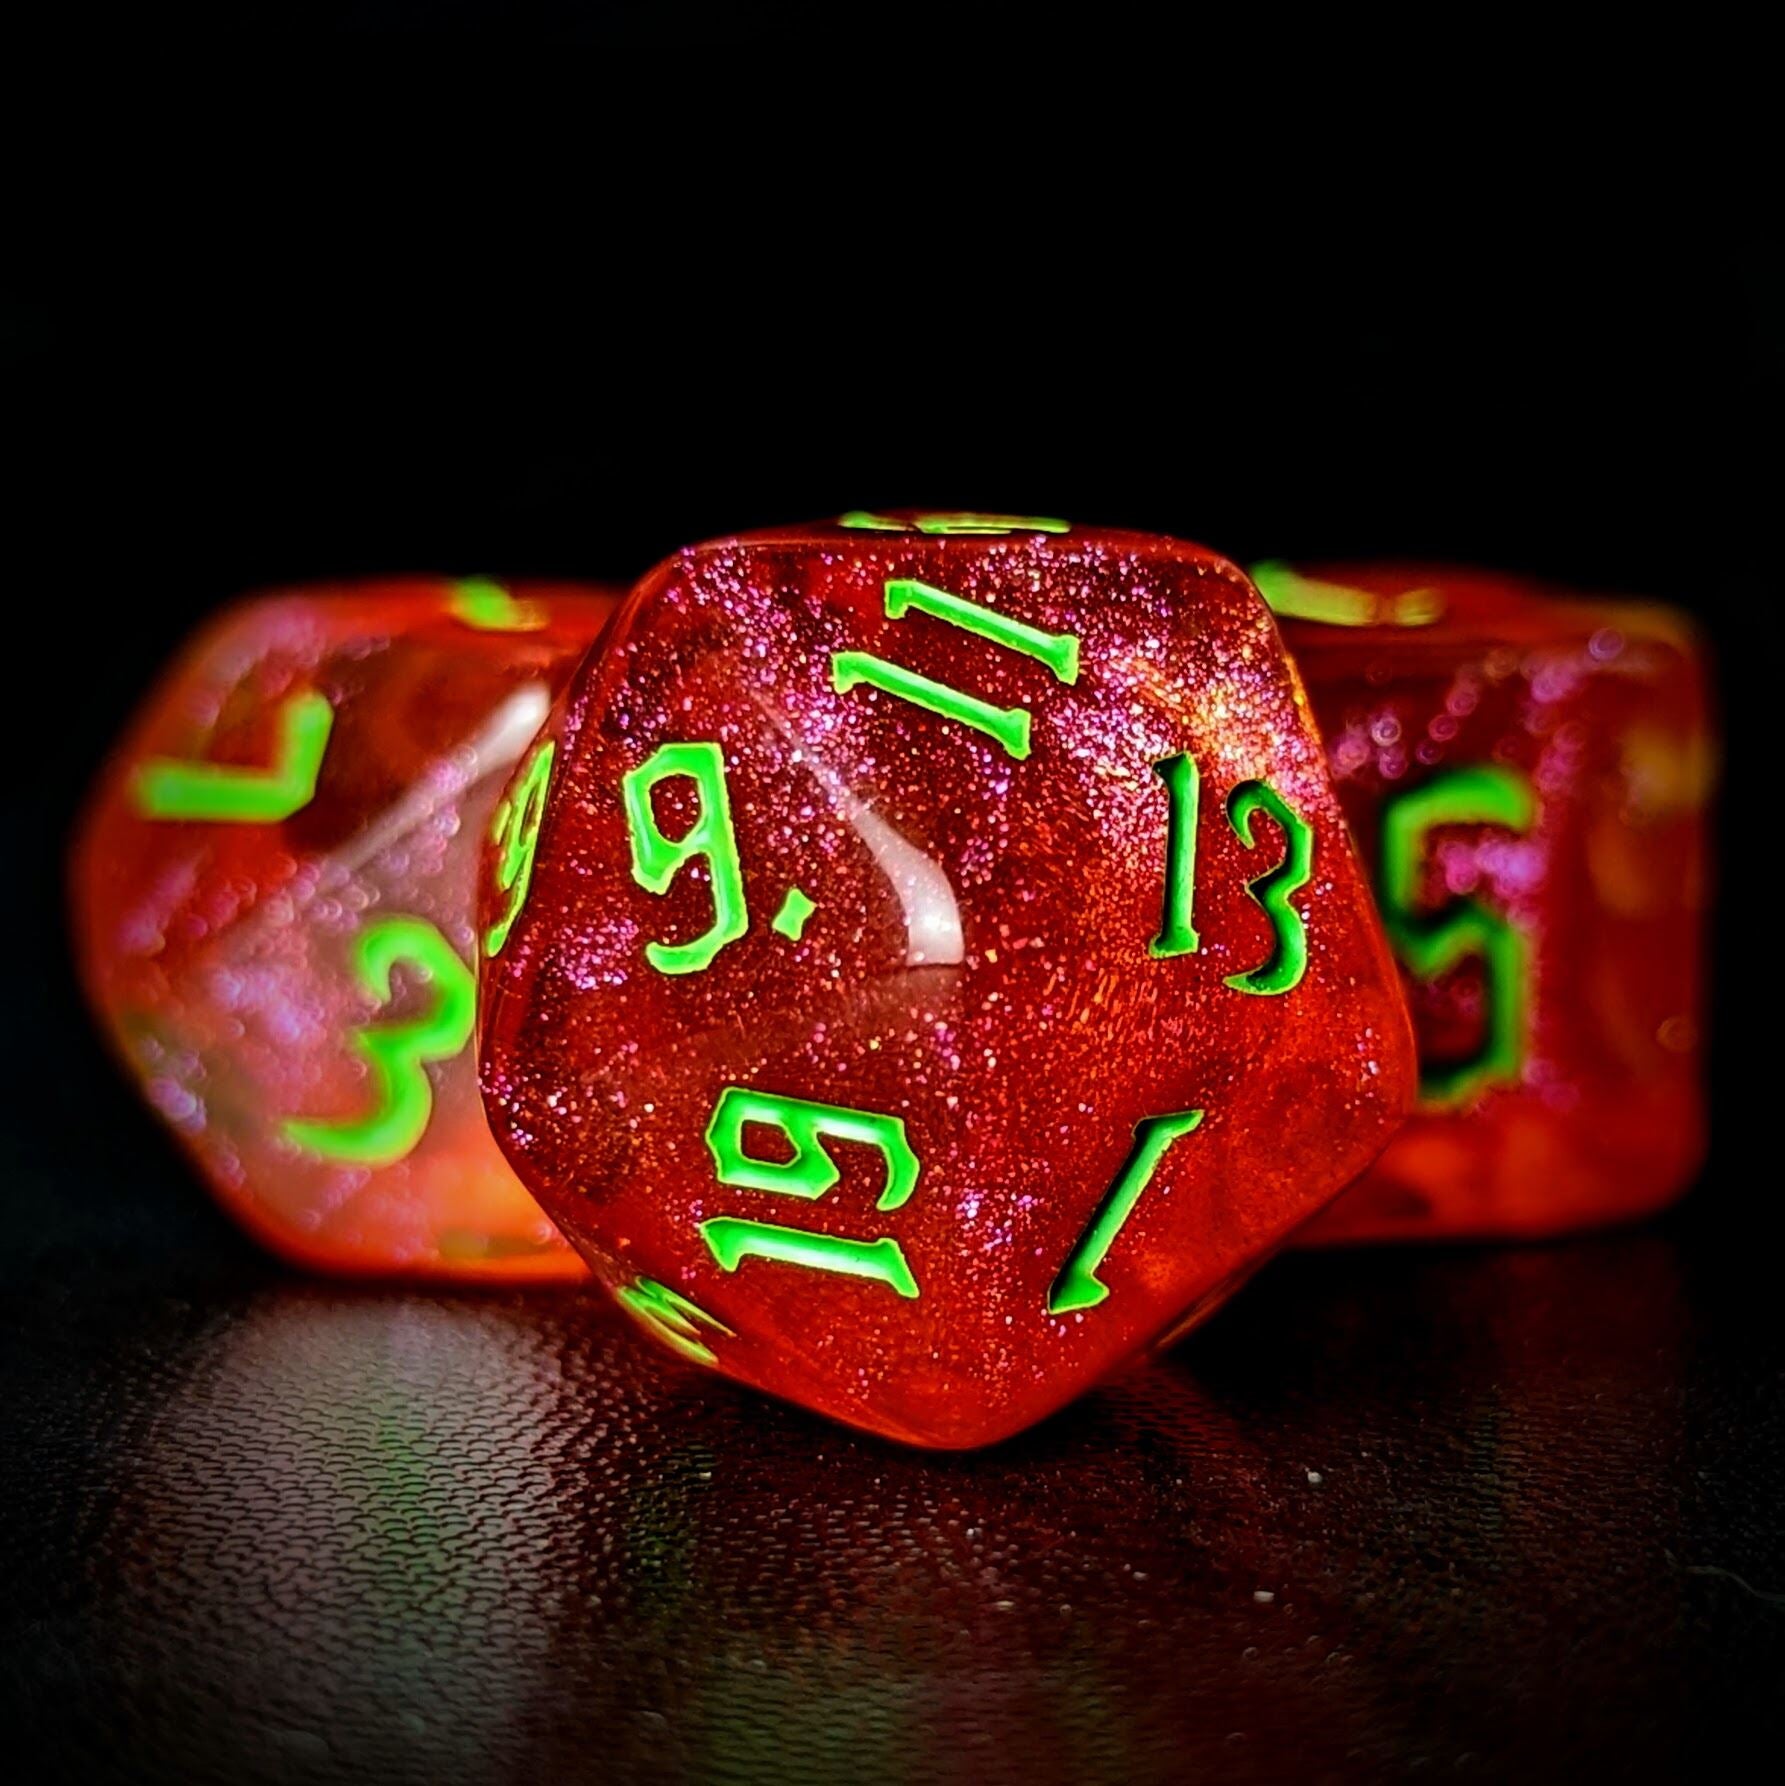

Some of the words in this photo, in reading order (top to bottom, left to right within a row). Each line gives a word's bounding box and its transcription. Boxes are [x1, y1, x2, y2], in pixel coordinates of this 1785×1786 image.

[831, 578, 1079, 760] 11
[1149, 753, 1313, 996] 13
[1382, 768, 1532, 1110] 5
[284, 917, 475, 1165] 3
[699, 1086, 920, 1299] 19
[1049, 1109, 1205, 1315] 1
